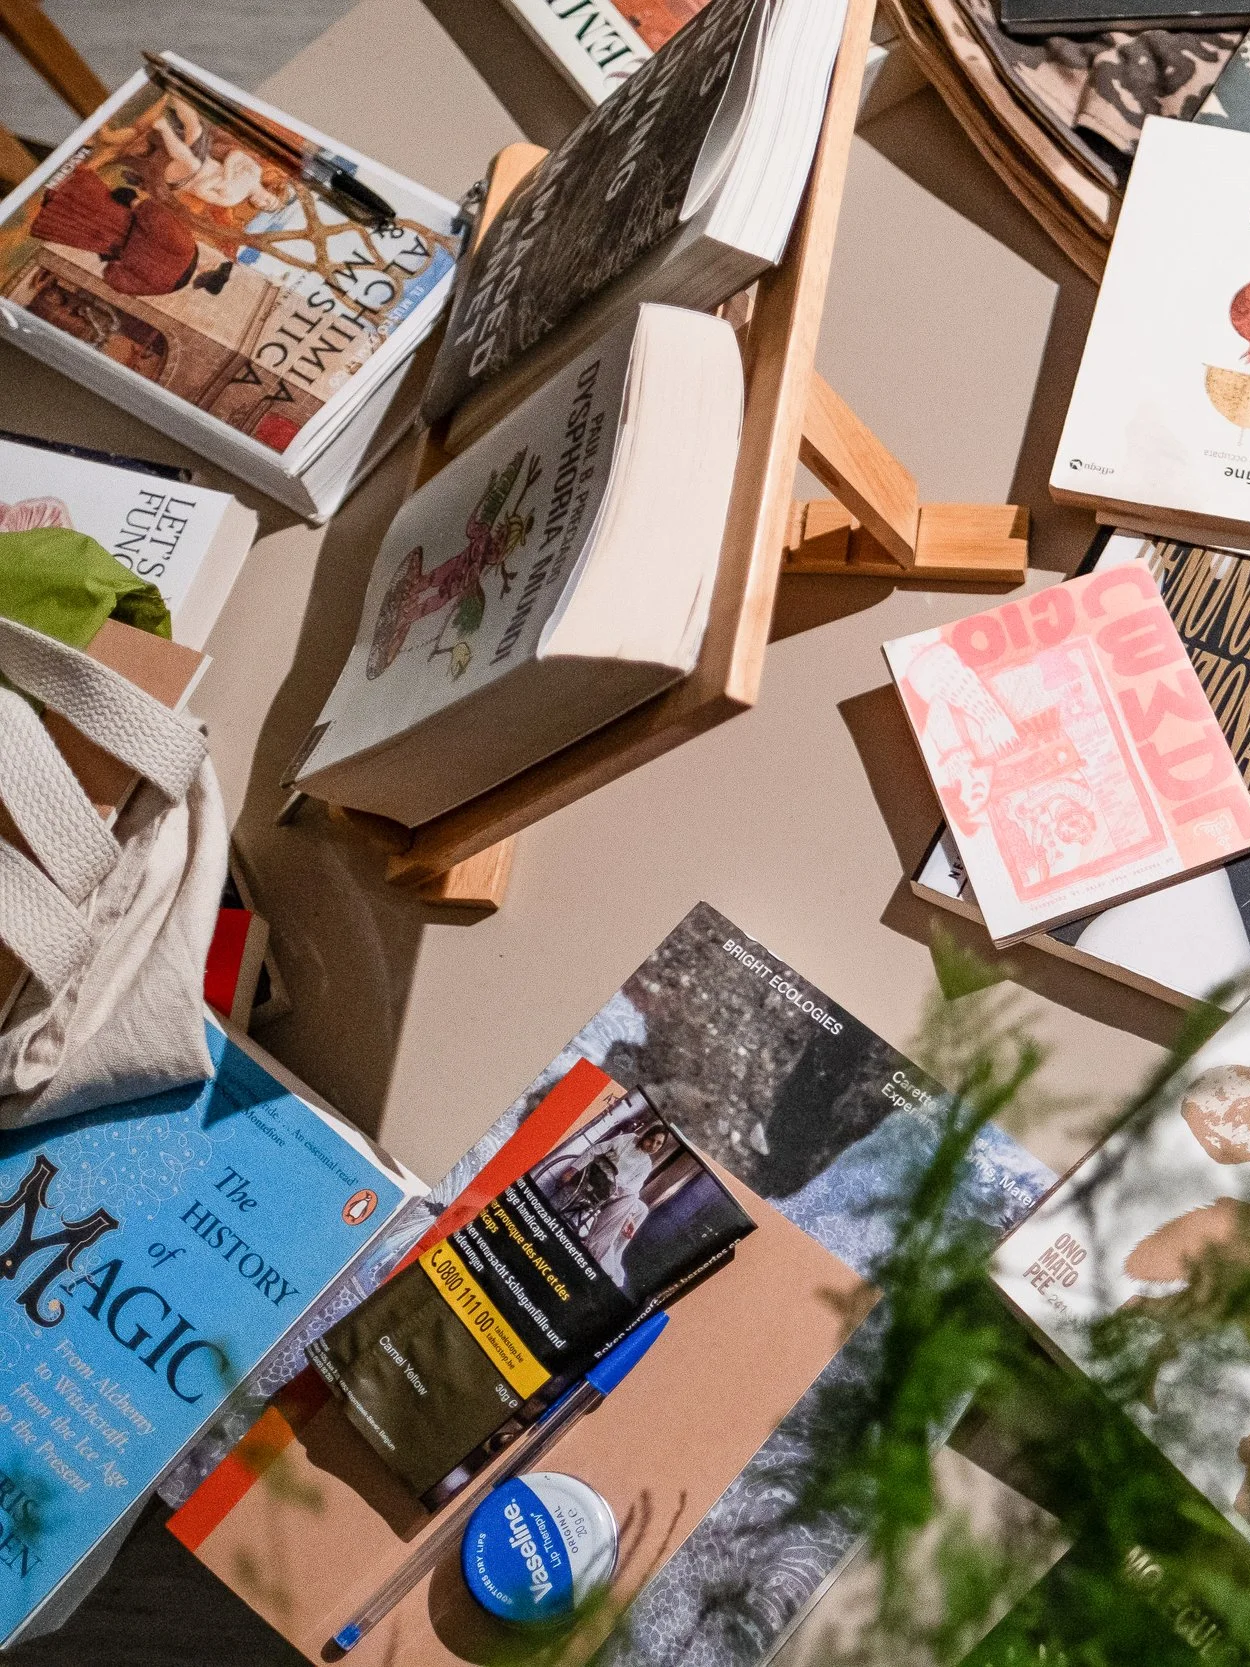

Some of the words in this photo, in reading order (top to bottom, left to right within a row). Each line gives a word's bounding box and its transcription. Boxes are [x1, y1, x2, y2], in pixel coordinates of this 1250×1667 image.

[230, 249, 374, 386] MISTICA
[263, 235, 430, 404] ALCHIMIA
[539, 360, 600, 551] DYSPHORIA
[134, 498, 196, 578] LET'S
[489, 555, 554, 664] MUNDI
[721, 937, 772, 981] BRIGHT
[767, 973, 844, 1037] ECOLOGIES
[214, 1166, 258, 1213] The
[513, 1201, 550, 1244] handicaps
[0, 1154, 229, 1405] MAGIC
[147, 1241, 187, 1268] of
[180, 1199, 300, 1307] HISTORY
[492, 1207, 526, 1246] provoque
[520, 1240, 539, 1259] des
[532, 1254, 552, 1276] AVC
[545, 1272, 559, 1286] et
[553, 1281, 572, 1302] des
[553, 1226, 590, 1270] beroertes
[583, 1265, 598, 1281] en
[1021, 1260, 1056, 1296] PEE
[1036, 1244, 1081, 1290] MATO
[1052, 1230, 1089, 1267] ONO
[433, 1258, 466, 1293] 0800
[453, 1285, 483, 1316] 111
[471, 1308, 497, 1334] 00
[492, 1324, 525, 1364] tabakstop.be
[473, 1234, 511, 1279] verursacht
[501, 1273, 552, 1334] Schlaganfälle
[546, 1327, 566, 1348] und
[51, 1335, 99, 1381] From
[88, 1371, 161, 1440] Alchemy
[377, 1334, 407, 1368] Camel
[400, 1363, 430, 1397] Yellow
[492, 1382, 511, 1403] 30g
[484, 1332, 516, 1371] tabacstop.be
[8, 1377, 57, 1424] from
[49, 1411, 81, 1442] the
[93, 1456, 133, 1496] Age
[32, 1359, 56, 1382] to
[47, 1373, 135, 1456] Witchcraft,
[9, 1415, 42, 1447] the
[32, 1437, 95, 1496] Present
[473, 1554, 487, 1574] DRY
[476, 1533, 485, 1552] LIPS
[548, 1549, 563, 1568] Lip
[552, 1503, 579, 1555] ORIGINAL
